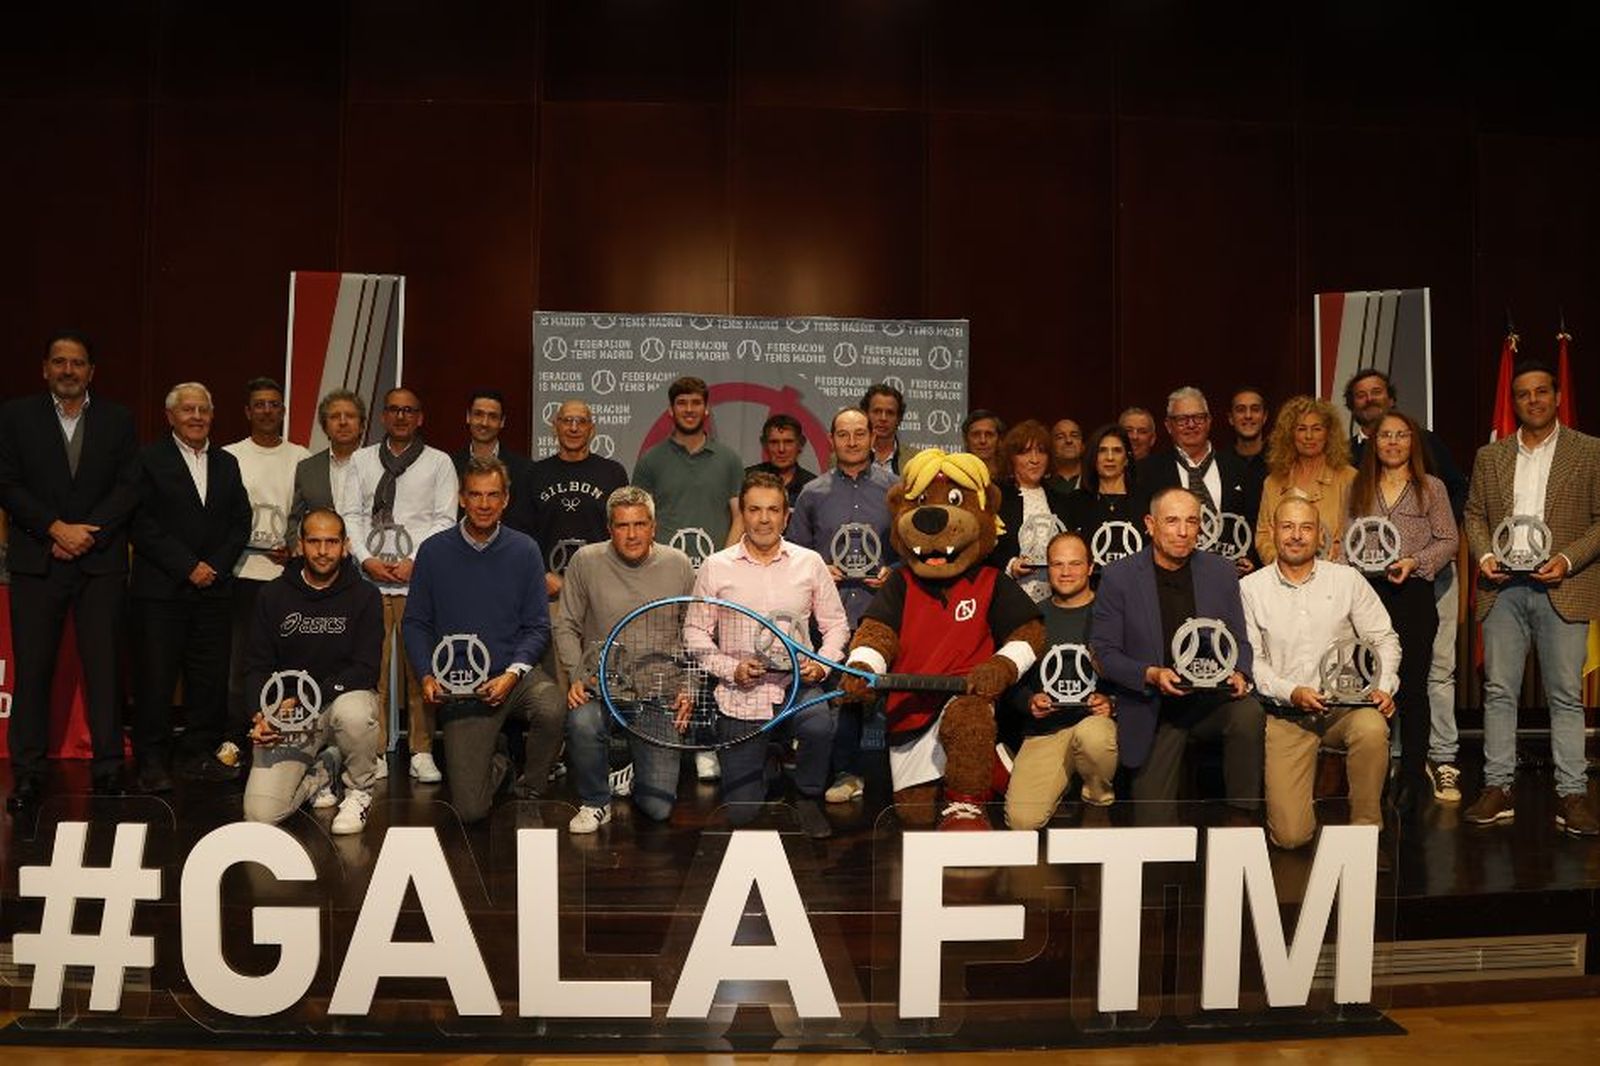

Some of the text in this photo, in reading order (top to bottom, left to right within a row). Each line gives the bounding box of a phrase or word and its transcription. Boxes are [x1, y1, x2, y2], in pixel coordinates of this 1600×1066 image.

[541, 481, 604, 501] SILBON
[12, 821, 1379, 1019] #GALA FTM
